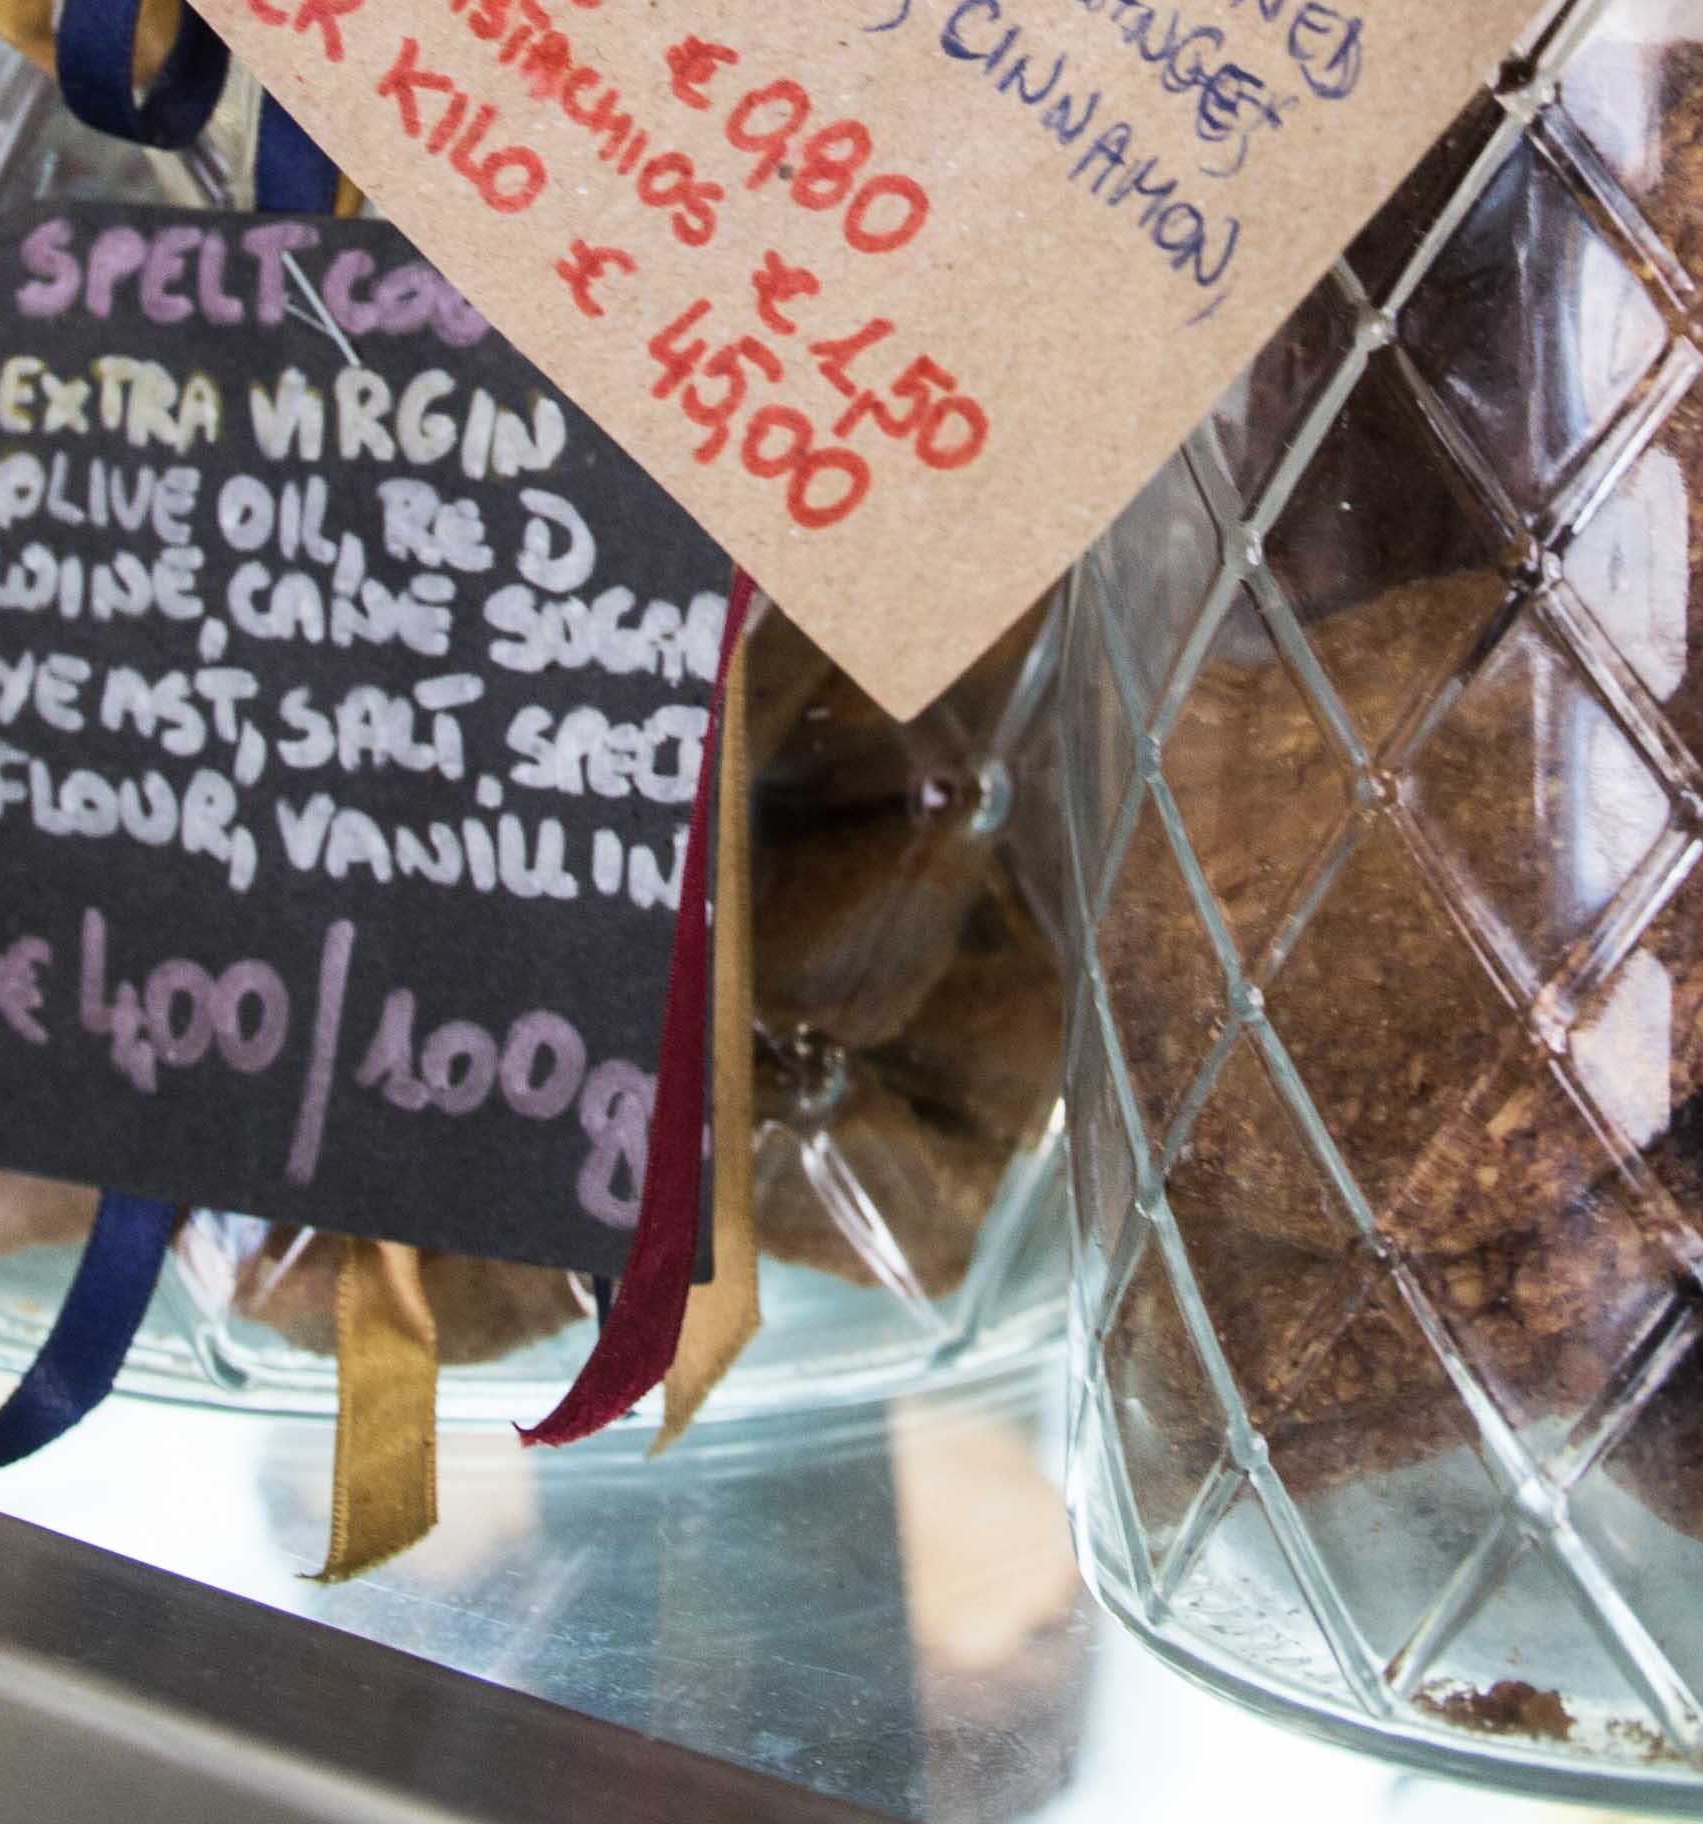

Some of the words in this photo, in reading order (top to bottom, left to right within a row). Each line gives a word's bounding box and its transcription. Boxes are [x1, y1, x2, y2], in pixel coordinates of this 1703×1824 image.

[376, 38, 548, 214] KILO
[15, 215, 320, 325] SPELT
[249, 368, 566, 480] VIRGIN
[227, 559, 456, 656] CANE
[276, 793, 692, 911] VANILLIN
